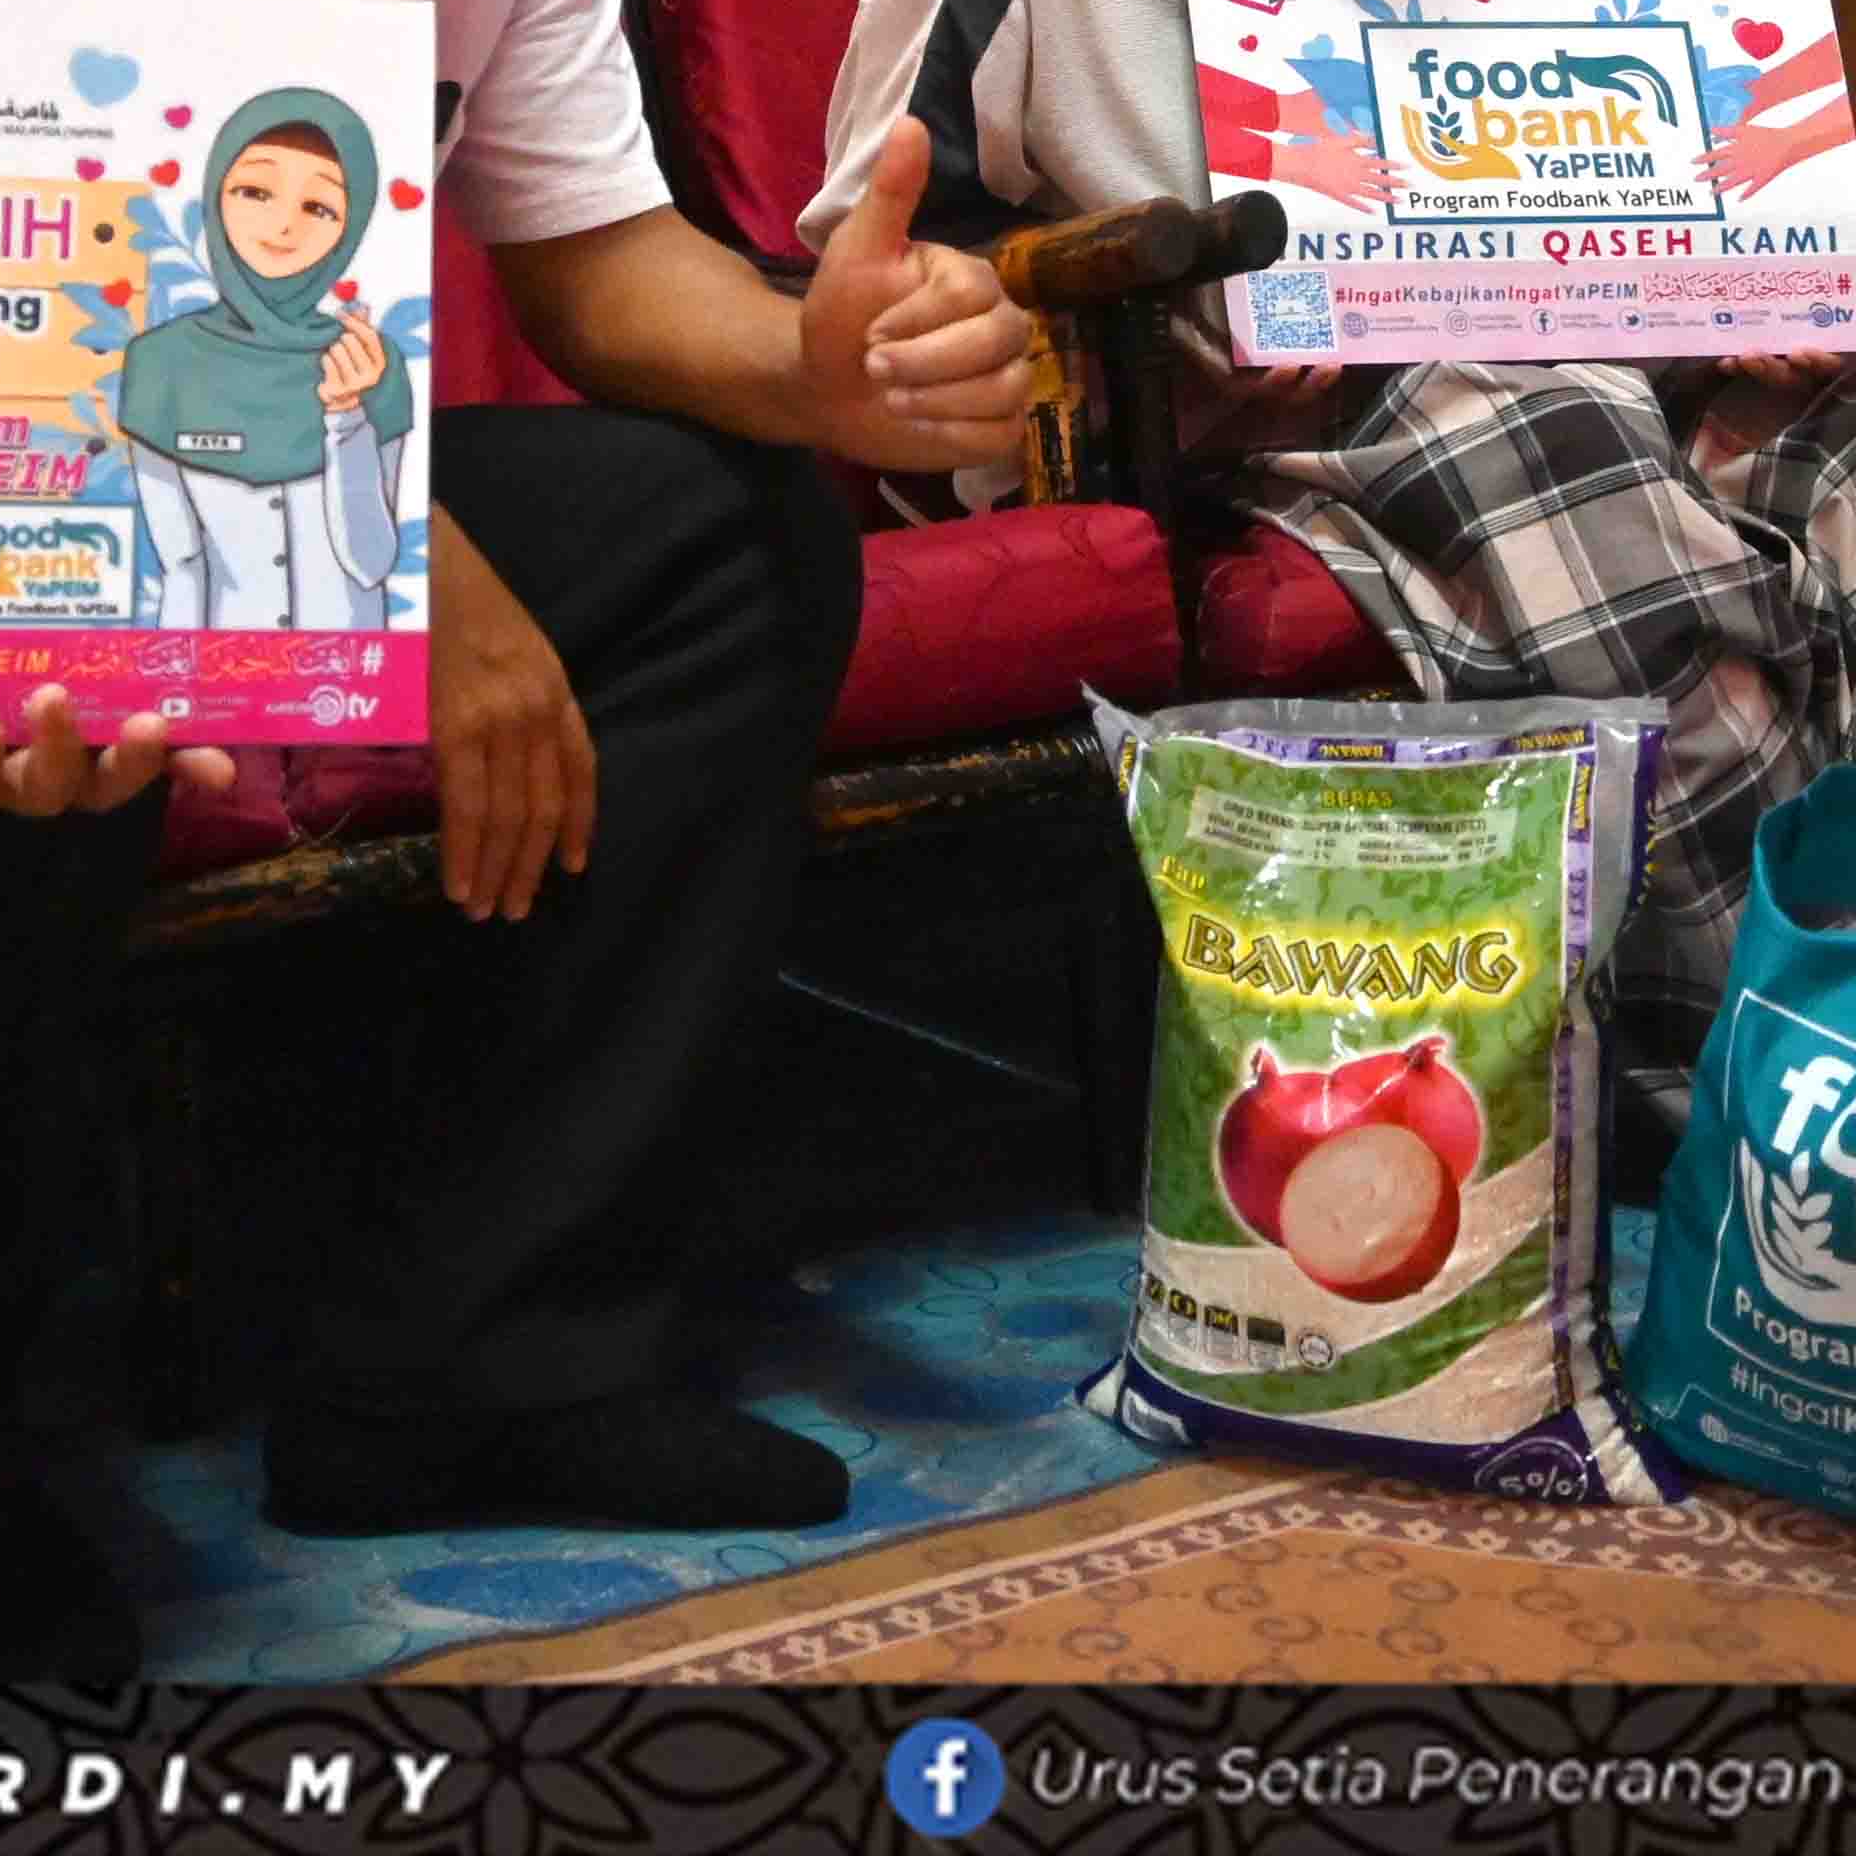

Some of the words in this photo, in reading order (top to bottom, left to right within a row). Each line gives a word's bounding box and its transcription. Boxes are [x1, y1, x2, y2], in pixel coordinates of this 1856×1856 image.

[1408, 49, 1576, 99] food
[1472, 96, 1648, 147] bank
[1526, 152, 1655, 179] YaPEIM
[1409, 192, 1500, 213] Program
[1508, 190, 1611, 208] Foodbank
[1618, 188, 1694, 207] YaPEIM
[1279, 231, 1515, 260] NSPIRASI
[1542, 228, 1692, 265] QASEH
[1720, 226, 1838, 255] KAMI
[1336, 283, 1639, 306] #IngatKebajikanIngatYaPEIM
[0, 546, 100, 578] bank
[1321, 790, 1393, 810] BERAS
[1182, 913, 1518, 1002] BAWANG
